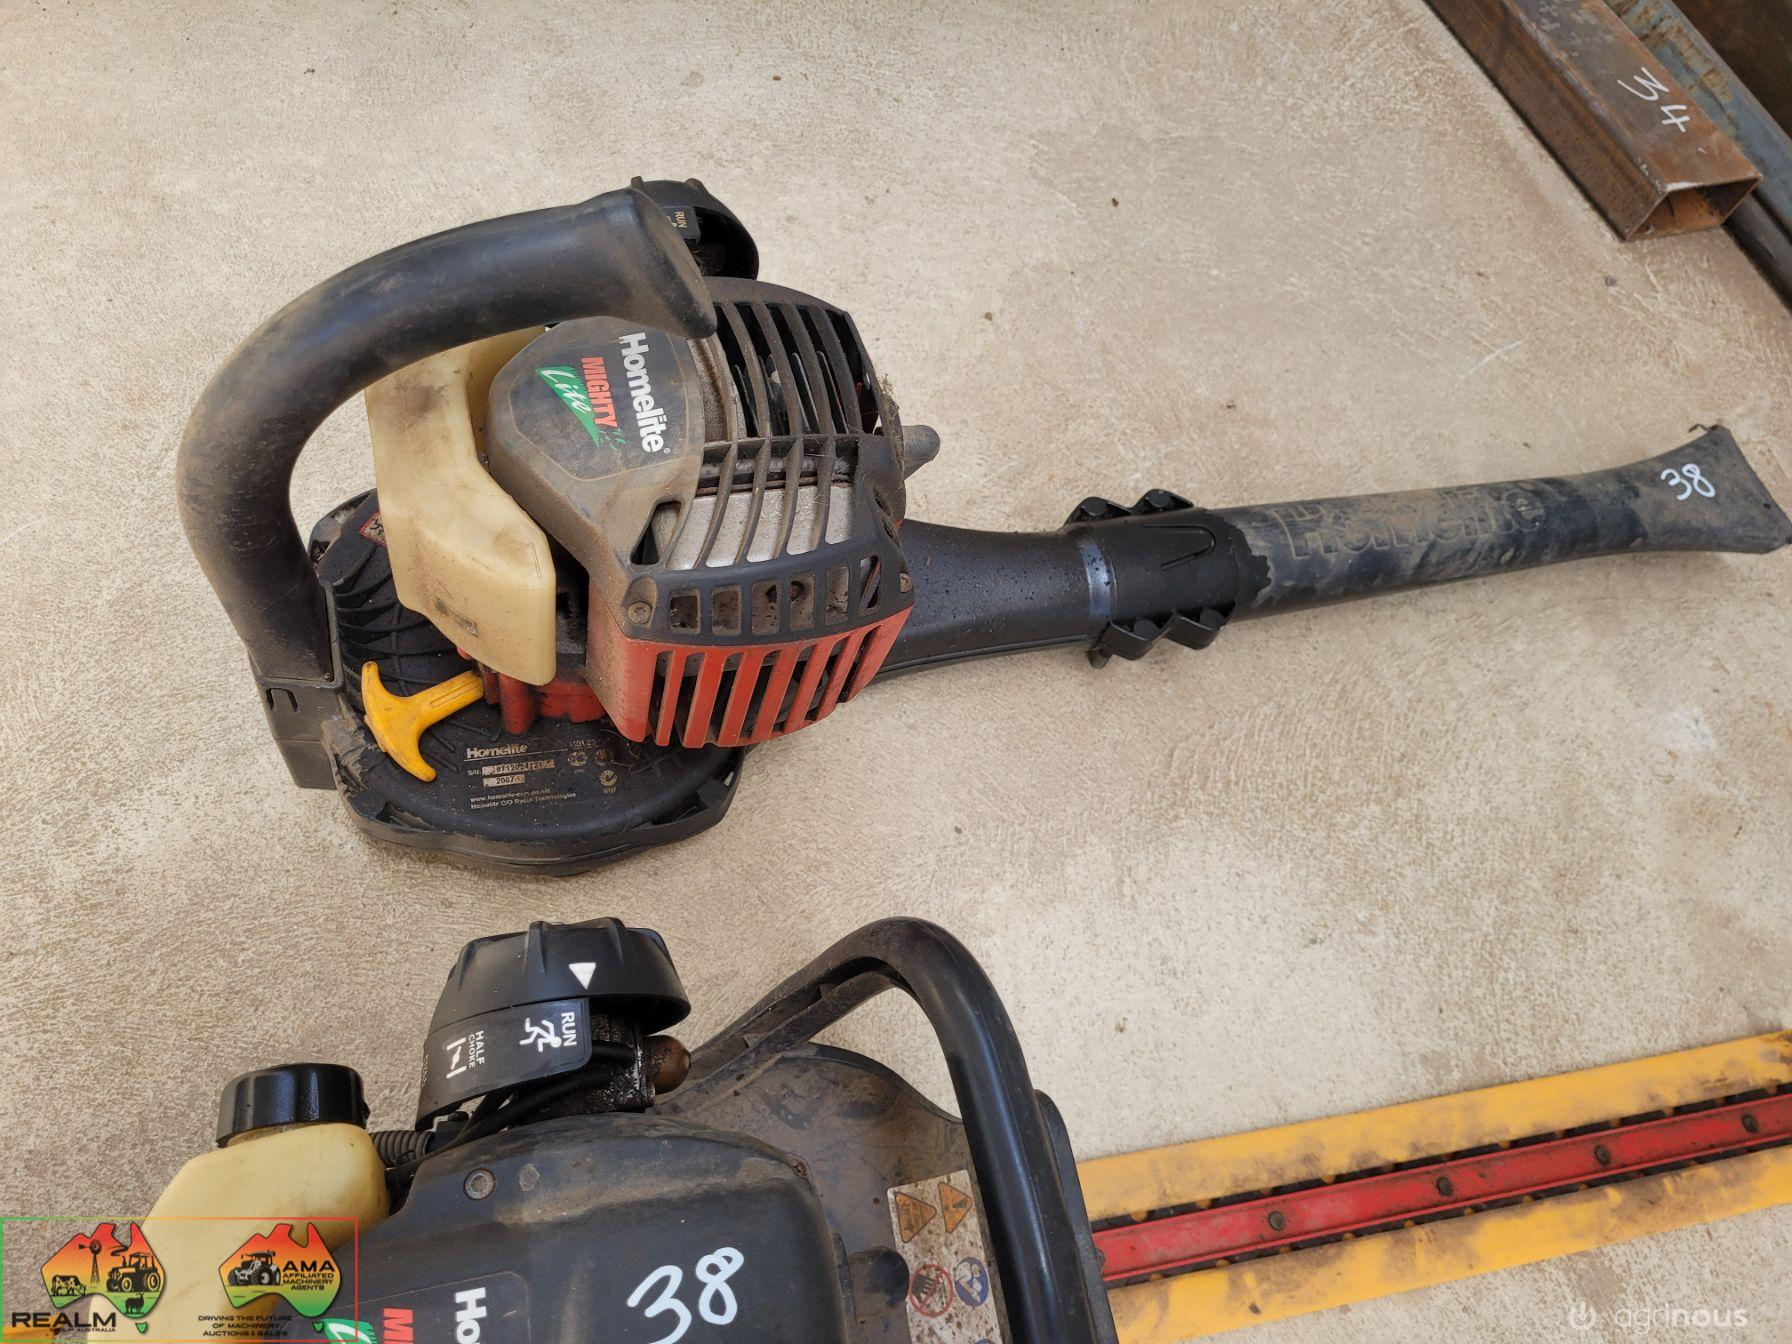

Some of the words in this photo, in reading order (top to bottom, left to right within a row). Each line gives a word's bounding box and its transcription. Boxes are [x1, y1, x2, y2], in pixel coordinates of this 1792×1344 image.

[1617, 66, 1690, 133] 34
[674, 211, 688, 228] RUN
[540, 369, 592, 414] Lite
[582, 357, 618, 428] MIGHTY
[619, 332, 667, 453] Homelite
[1661, 463, 1716, 500] 38
[466, 743, 528, 759] Homelite
[475, 1030, 486, 1065] HALF
[560, 1011, 578, 1047] RUN
[468, 1033, 476, 1069] CHOKE
[627, 1246, 744, 1344] 38
